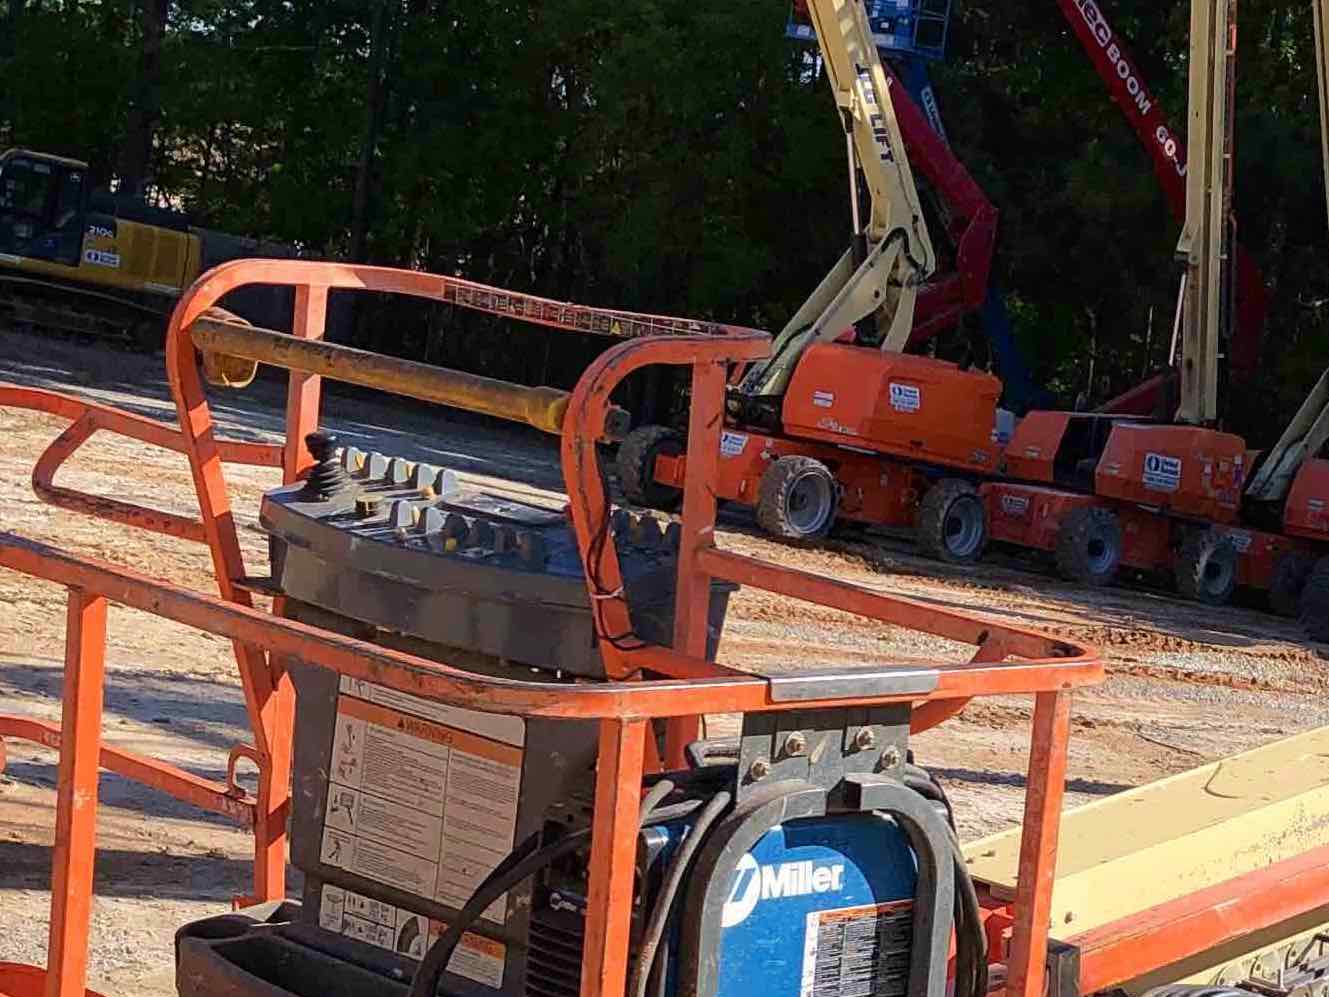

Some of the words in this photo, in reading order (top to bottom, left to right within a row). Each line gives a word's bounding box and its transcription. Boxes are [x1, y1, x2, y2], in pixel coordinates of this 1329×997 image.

[1107, 43, 1152, 116] BOOM
[869, 114, 894, 162] LIFT
[761, 861, 846, 900] Miller
